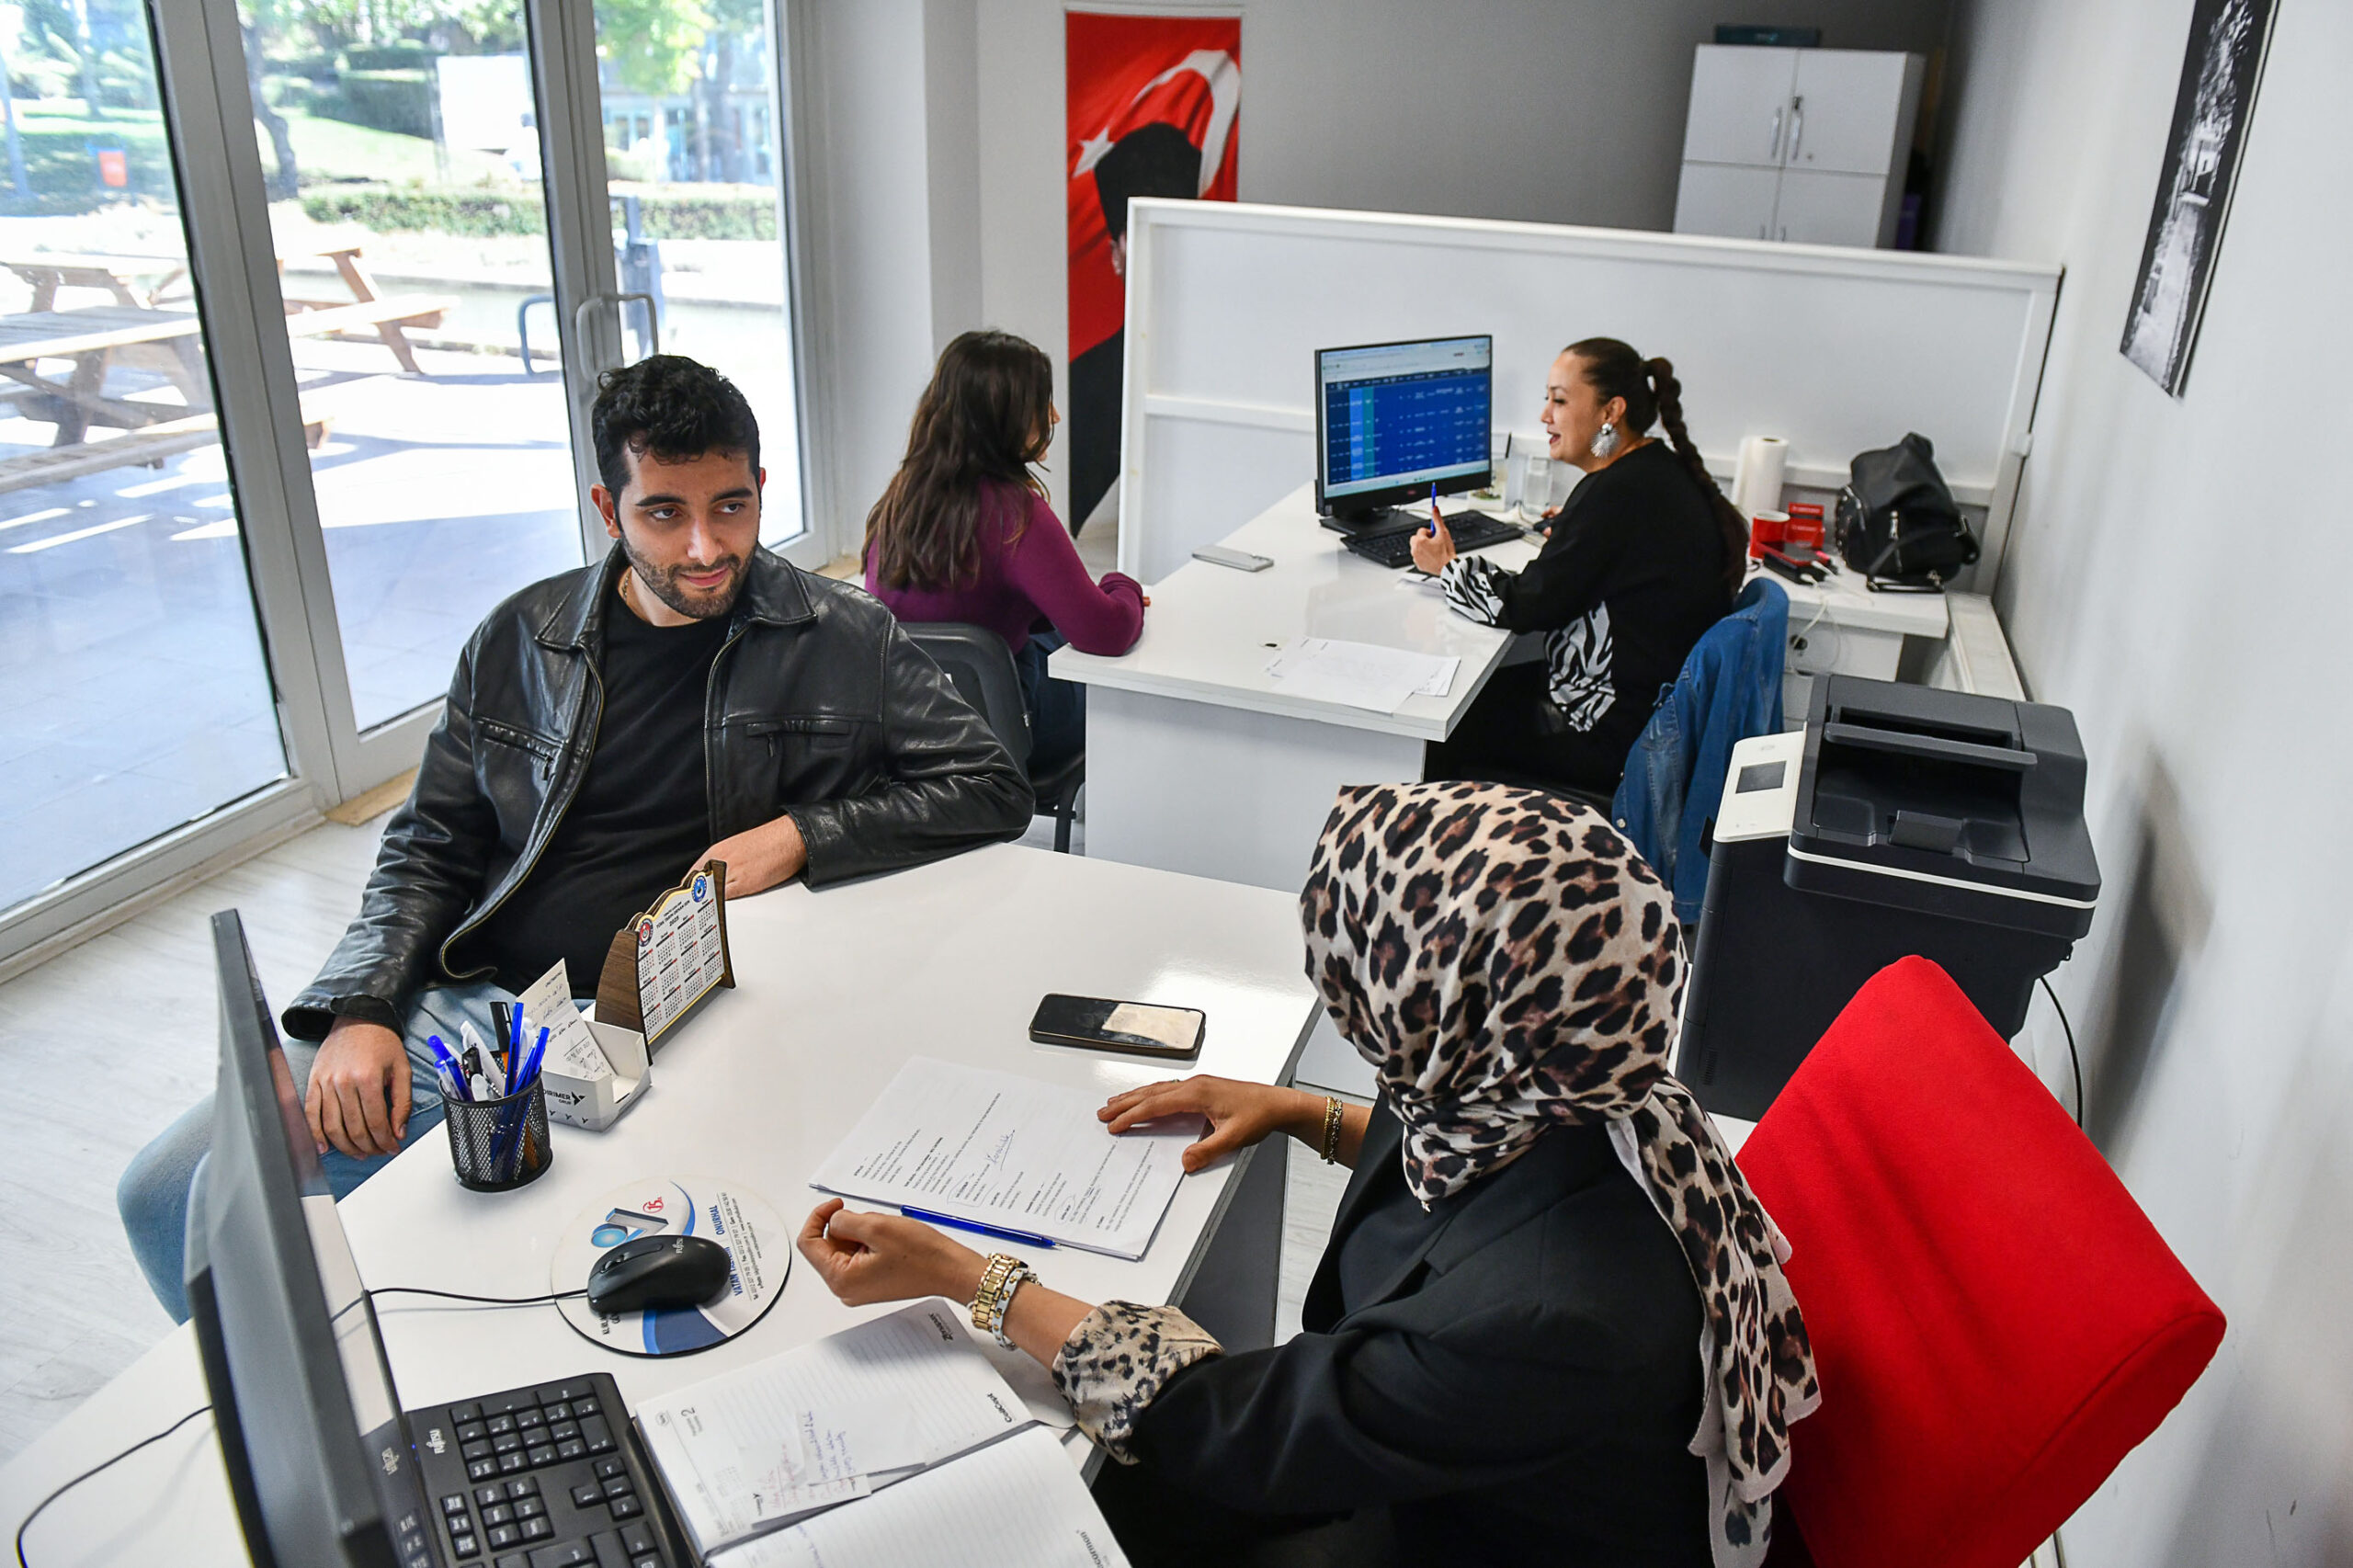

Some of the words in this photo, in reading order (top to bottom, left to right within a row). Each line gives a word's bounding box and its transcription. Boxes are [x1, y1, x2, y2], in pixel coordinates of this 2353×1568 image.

[709, 1205, 725, 1235] ONURHAL
[730, 1274, 743, 1297] VATAN
[681, 1407, 695, 1416] 2
[426, 1428, 446, 1454] FUJITSU
